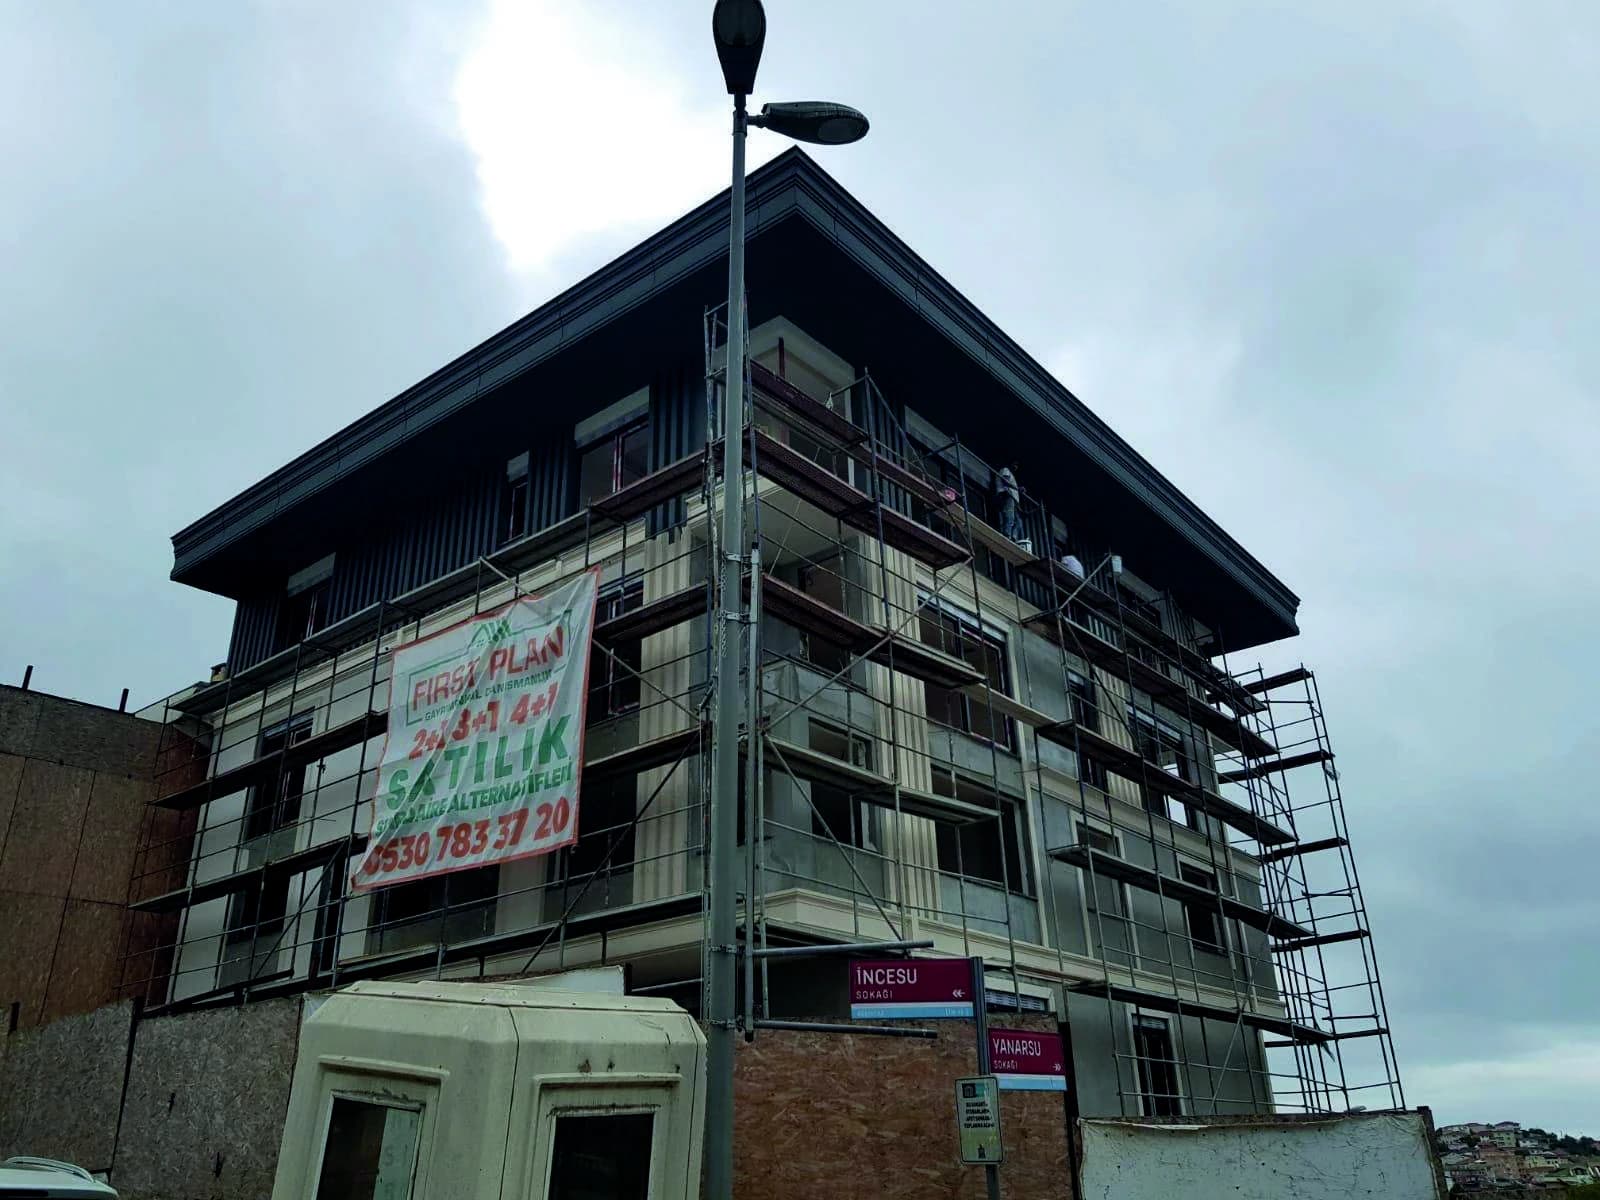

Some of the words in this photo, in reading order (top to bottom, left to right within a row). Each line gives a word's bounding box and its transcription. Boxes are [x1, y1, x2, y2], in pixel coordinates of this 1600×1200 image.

[413, 657, 480, 711] FIRST
[489, 625, 564, 681] PLAN
[452, 700, 499, 741] 3+1
[509, 682, 558, 725] 4+1
[387, 714, 571, 810] SATILIK
[364, 831, 431, 876] 0530
[436, 818, 490, 862] 783
[493, 807, 529, 850] 37
[534, 796, 570, 841] 20
[855, 989, 893, 1000] SOKAĞI
[856, 966, 918, 985] İNCESU
[992, 1038, 1041, 1056] YANARSU
